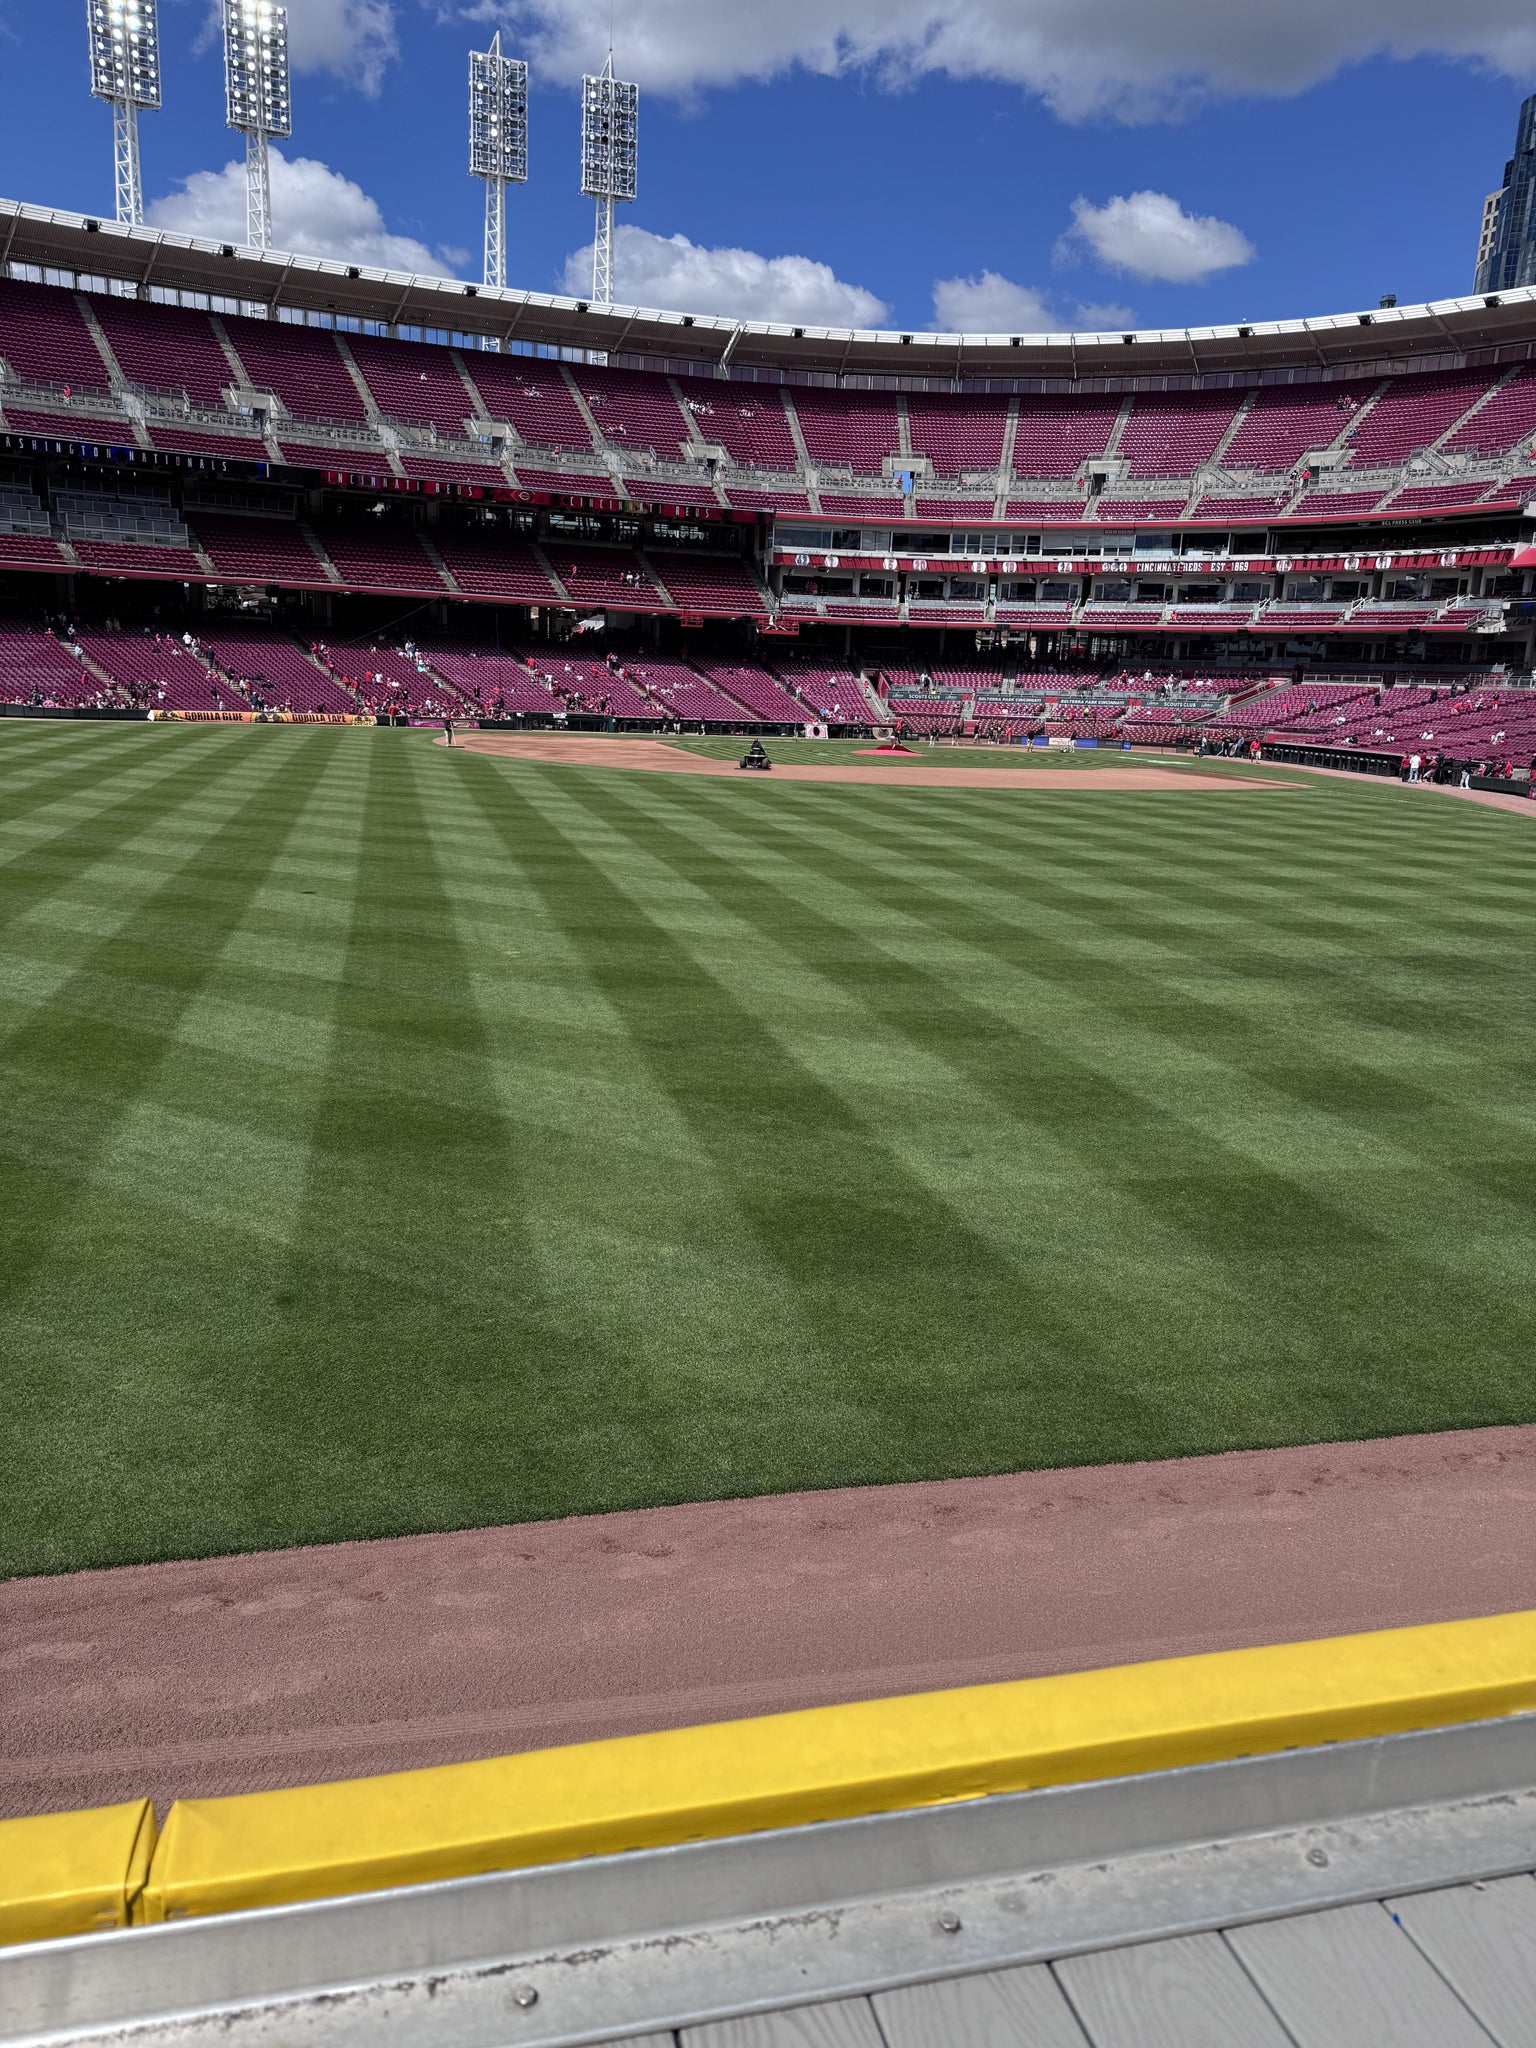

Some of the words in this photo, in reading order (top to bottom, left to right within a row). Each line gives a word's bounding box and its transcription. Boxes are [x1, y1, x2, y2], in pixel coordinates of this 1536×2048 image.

[129, 450, 227, 472] NATIONALS
[435, 482, 473, 496] REDS
[570, 496, 662, 514] CINCINNATI
[675, 506, 710, 518] REDS
[1137, 561, 1181, 573] CINCINNATI
[1210, 562, 1229, 572] EST.
[1231, 561, 1249, 572] 1869
[184, 711, 219, 721] GORILLA
[221, 712, 243, 721] GLUE
[292, 713, 325, 723] GORILLA
[327, 714, 347, 723] TAPE
